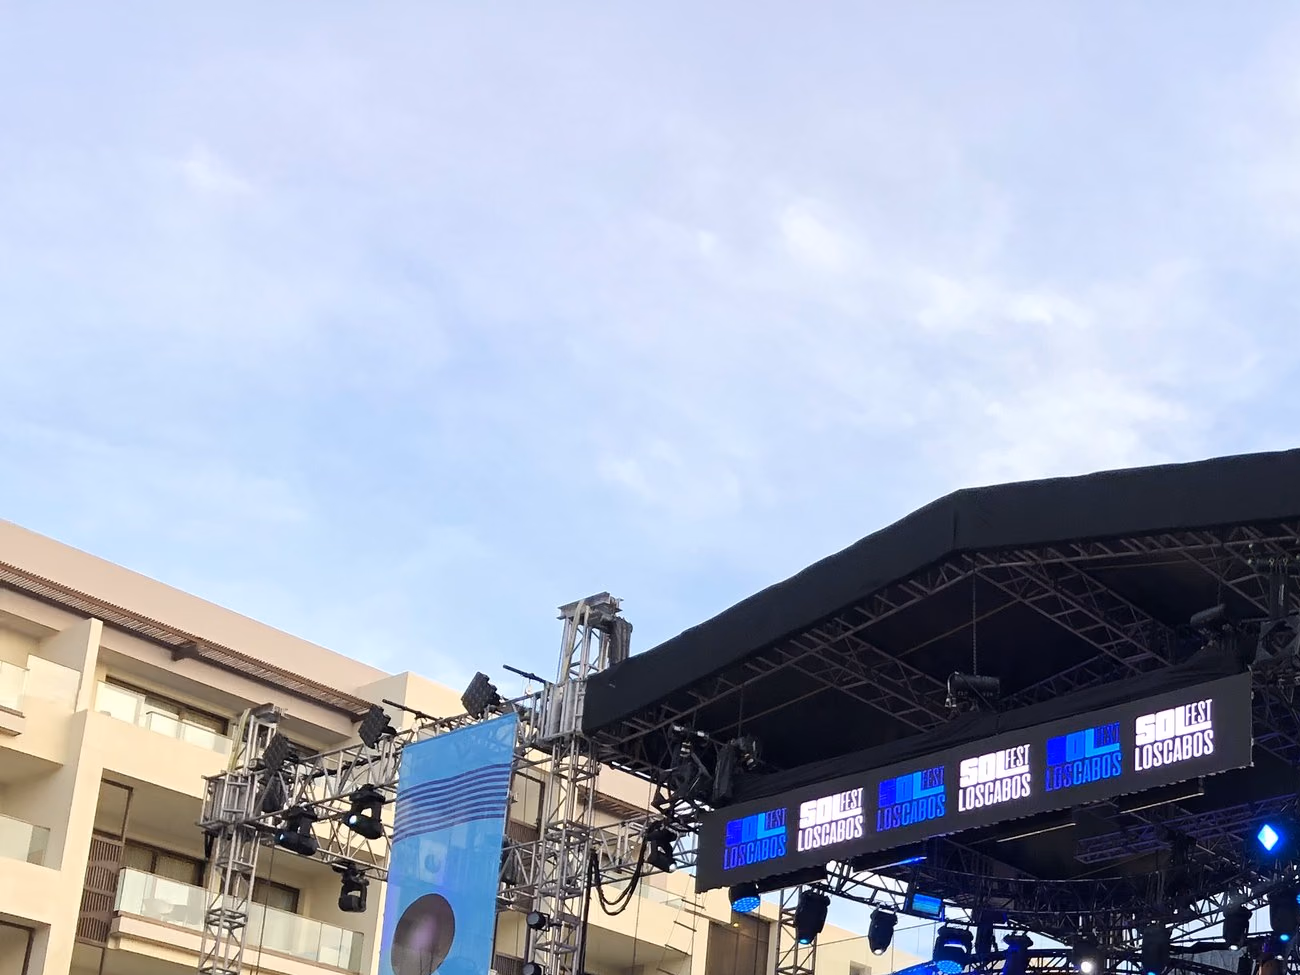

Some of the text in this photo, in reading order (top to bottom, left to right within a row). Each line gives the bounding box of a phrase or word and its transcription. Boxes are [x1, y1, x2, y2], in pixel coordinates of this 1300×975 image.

[1135, 699, 1213, 746] SOL FEST
[959, 743, 1031, 788] SOL FEST
[1134, 729, 1214, 772] LOSCABOS
[1045, 752, 1122, 792] LOSCABOS
[799, 787, 863, 829] SOL FEST
[958, 773, 1032, 812] LOSCABOS
[876, 794, 946, 832] LOSCABOS
[723, 834, 787, 870] LOSCABOS
[797, 815, 864, 852] LOSCABOS
